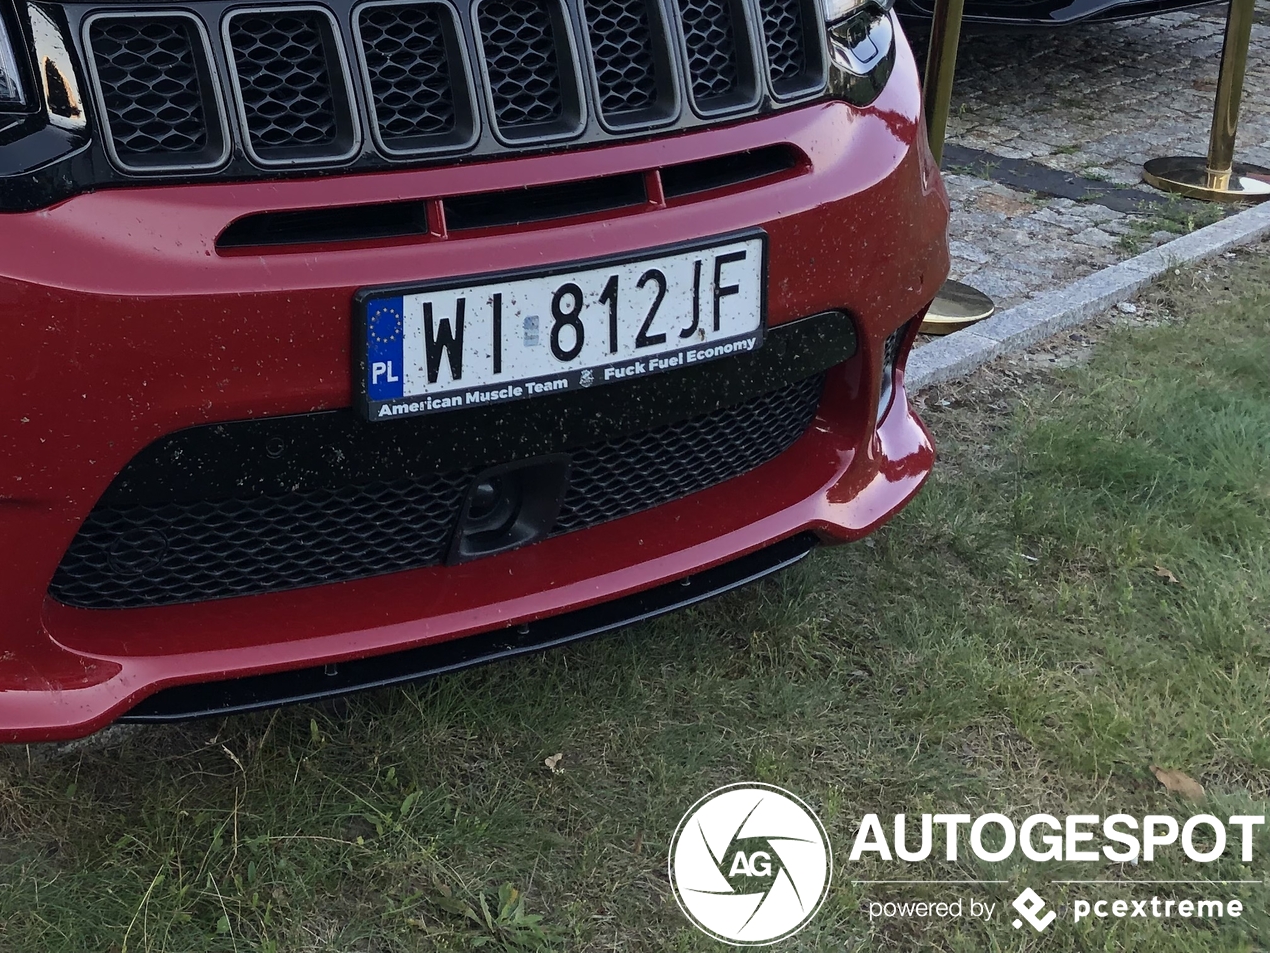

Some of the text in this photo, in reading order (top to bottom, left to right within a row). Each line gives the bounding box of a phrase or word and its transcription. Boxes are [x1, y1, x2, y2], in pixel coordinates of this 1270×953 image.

[371, 250, 748, 385] PL WI 812JF
[378, 336, 757, 417] American Muscle Team Fuck Fuel Economy
